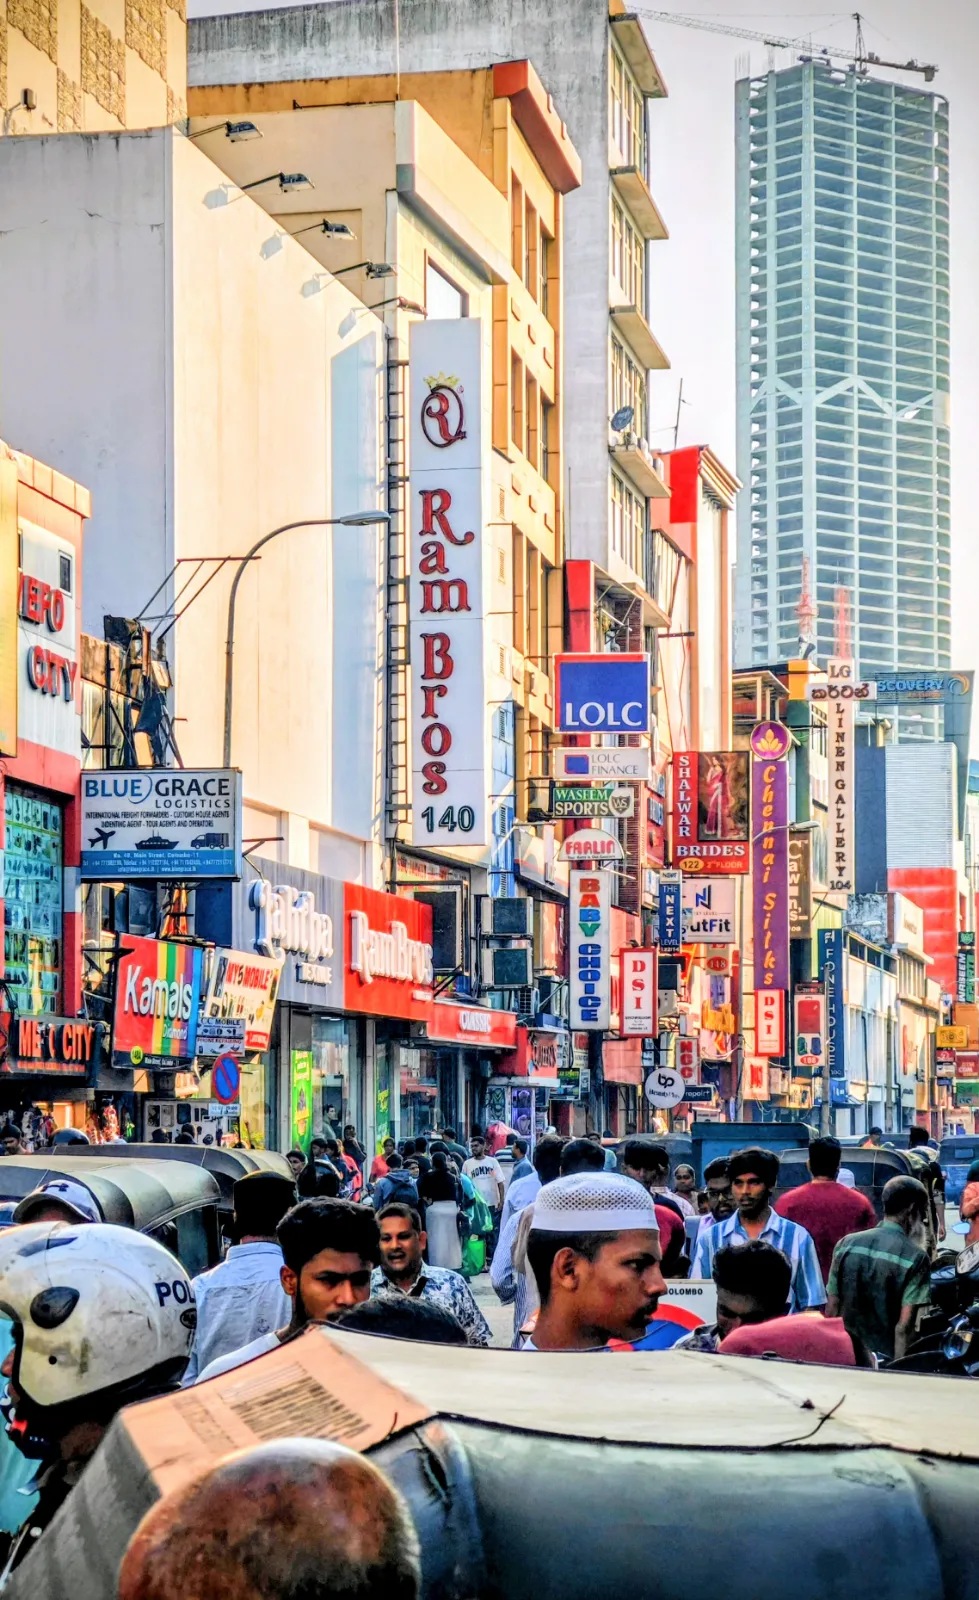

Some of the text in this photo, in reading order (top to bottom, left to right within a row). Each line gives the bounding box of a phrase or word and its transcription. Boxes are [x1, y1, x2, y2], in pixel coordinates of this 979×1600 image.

[418, 489, 475, 795] Ram Bros
[27, 645, 78, 702] CITY
[830, 664, 852, 678] LG
[565, 702, 642, 726] LOLC
[591, 754, 620, 763] LOLC
[592, 765, 639, 775] FINANCE
[85, 778, 230, 798] BLUE GRACE
[555, 789, 609, 800] WASEEM
[677, 755, 692, 837] SHALWAR
[835, 702, 846, 877] LINEN GALLERY
[85, 811, 120, 819] INTERNATIONAL
[140, 811, 169, 819] FORWARDERS
[174, 810, 194, 818] CUSTOMS
[195, 810, 211, 818] HOUSE
[212, 810, 230, 818] AGENTS
[155, 799, 230, 809] LOGISTICS
[555, 802, 609, 815] SPORTS
[127, 820, 142, 828] AGENT
[146, 820, 158, 828] TOUR
[159, 820, 176, 828] AGENTS
[177, 820, 187, 828] AND
[189, 820, 214, 828] OPERATORS
[421, 805, 475, 833] 140
[676, 845, 745, 857] BRIDES
[683, 861, 699, 869] 122
[762, 766, 777, 985] Chennai Silks
[829, 880, 852, 890] 104
[578, 878, 601, 937] BABY
[665, 895, 675, 937] NEXT
[686, 919, 731, 933] utFit
[124, 965, 192, 1021] Kamals
[578, 944, 601, 1021] CHOICE
[632, 960, 646, 1010] DSI
[459, 1011, 492, 1033] CLASSIC
[764, 996, 775, 1035] DSI
[62, 1022, 95, 1060] CITY
[154, 1280, 196, 1307] POL
[667, 1288, 704, 1296] OLOMBO
